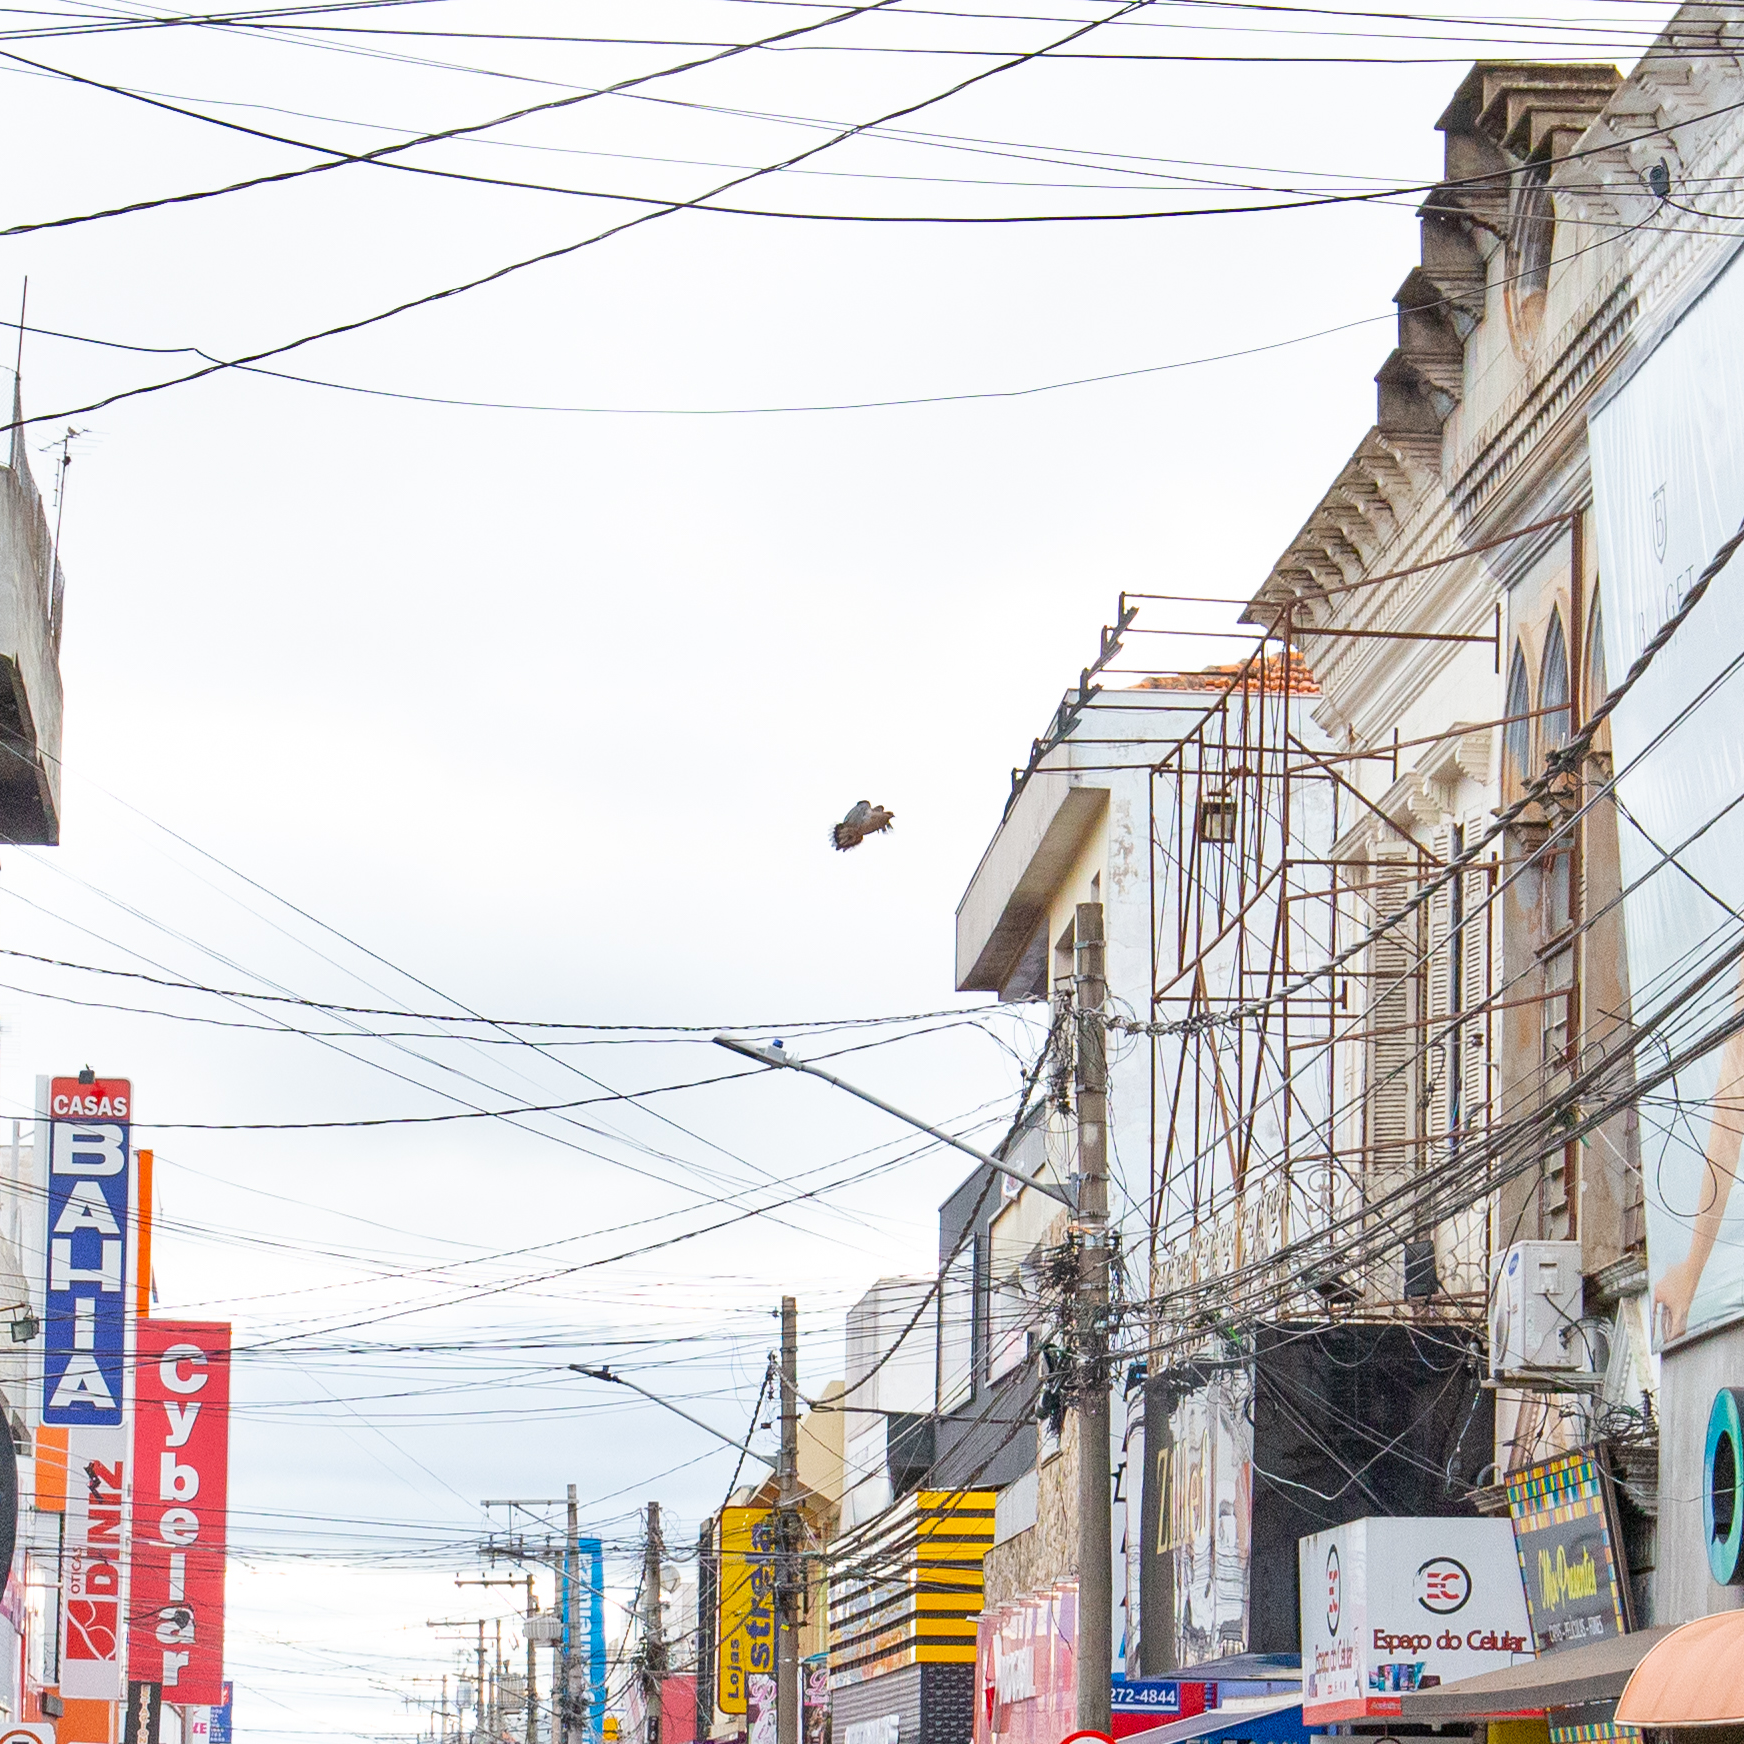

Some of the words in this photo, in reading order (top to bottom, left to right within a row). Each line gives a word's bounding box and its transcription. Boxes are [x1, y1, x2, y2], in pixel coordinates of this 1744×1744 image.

[53, 1094, 127, 1117] CASAS
[48, 1124, 126, 1409] BAHIA
[85, 1459, 124, 1597] DINIZ
[155, 1343, 209, 1688] Cybelar
[70, 1546, 83, 1595] ÓTICAS
[727, 1638, 744, 1699] Lojas
[1373, 1628, 1432, 1655] Espaço
[1436, 1629, 1462, 1650] do
[1467, 1629, 1527, 1652] Celular
